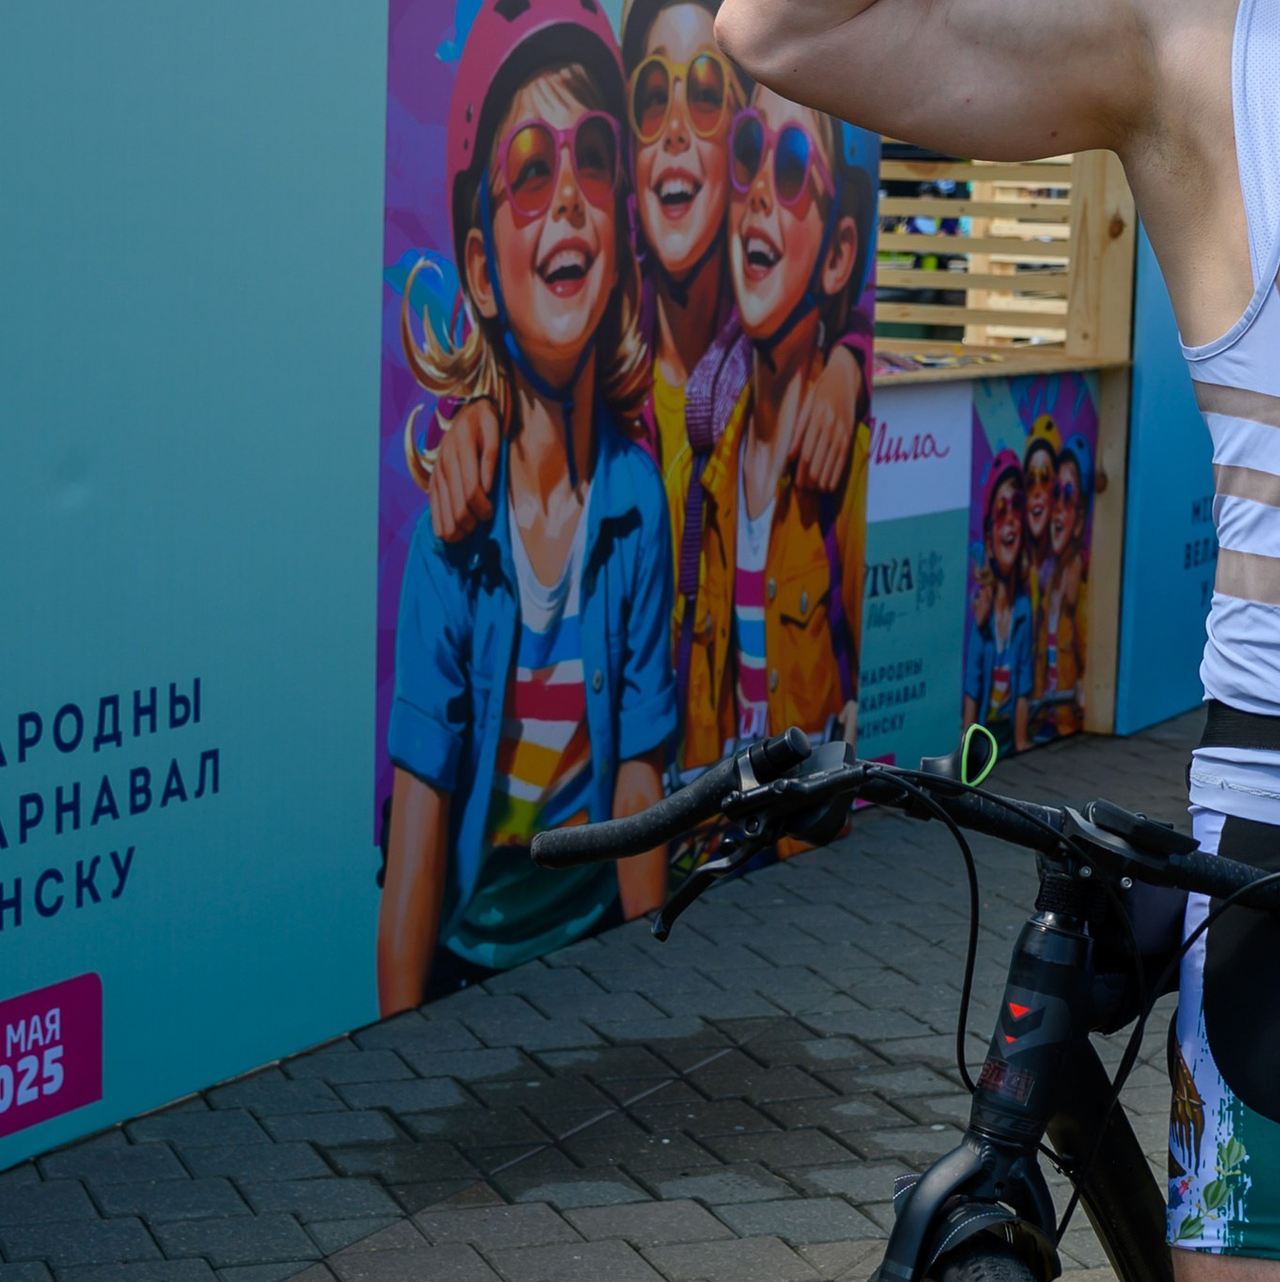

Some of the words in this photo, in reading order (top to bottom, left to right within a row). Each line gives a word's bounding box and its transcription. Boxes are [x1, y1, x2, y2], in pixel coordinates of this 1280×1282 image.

[859, 680, 926, 714] КАРНАВАЛ
[860, 657, 924, 687] НАРОДНЫ
[0, 677, 201, 767] РОДНЫ
[0, 748, 219, 850] РНАВАЛ
[6, 1007, 61, 1058] МАЯ
